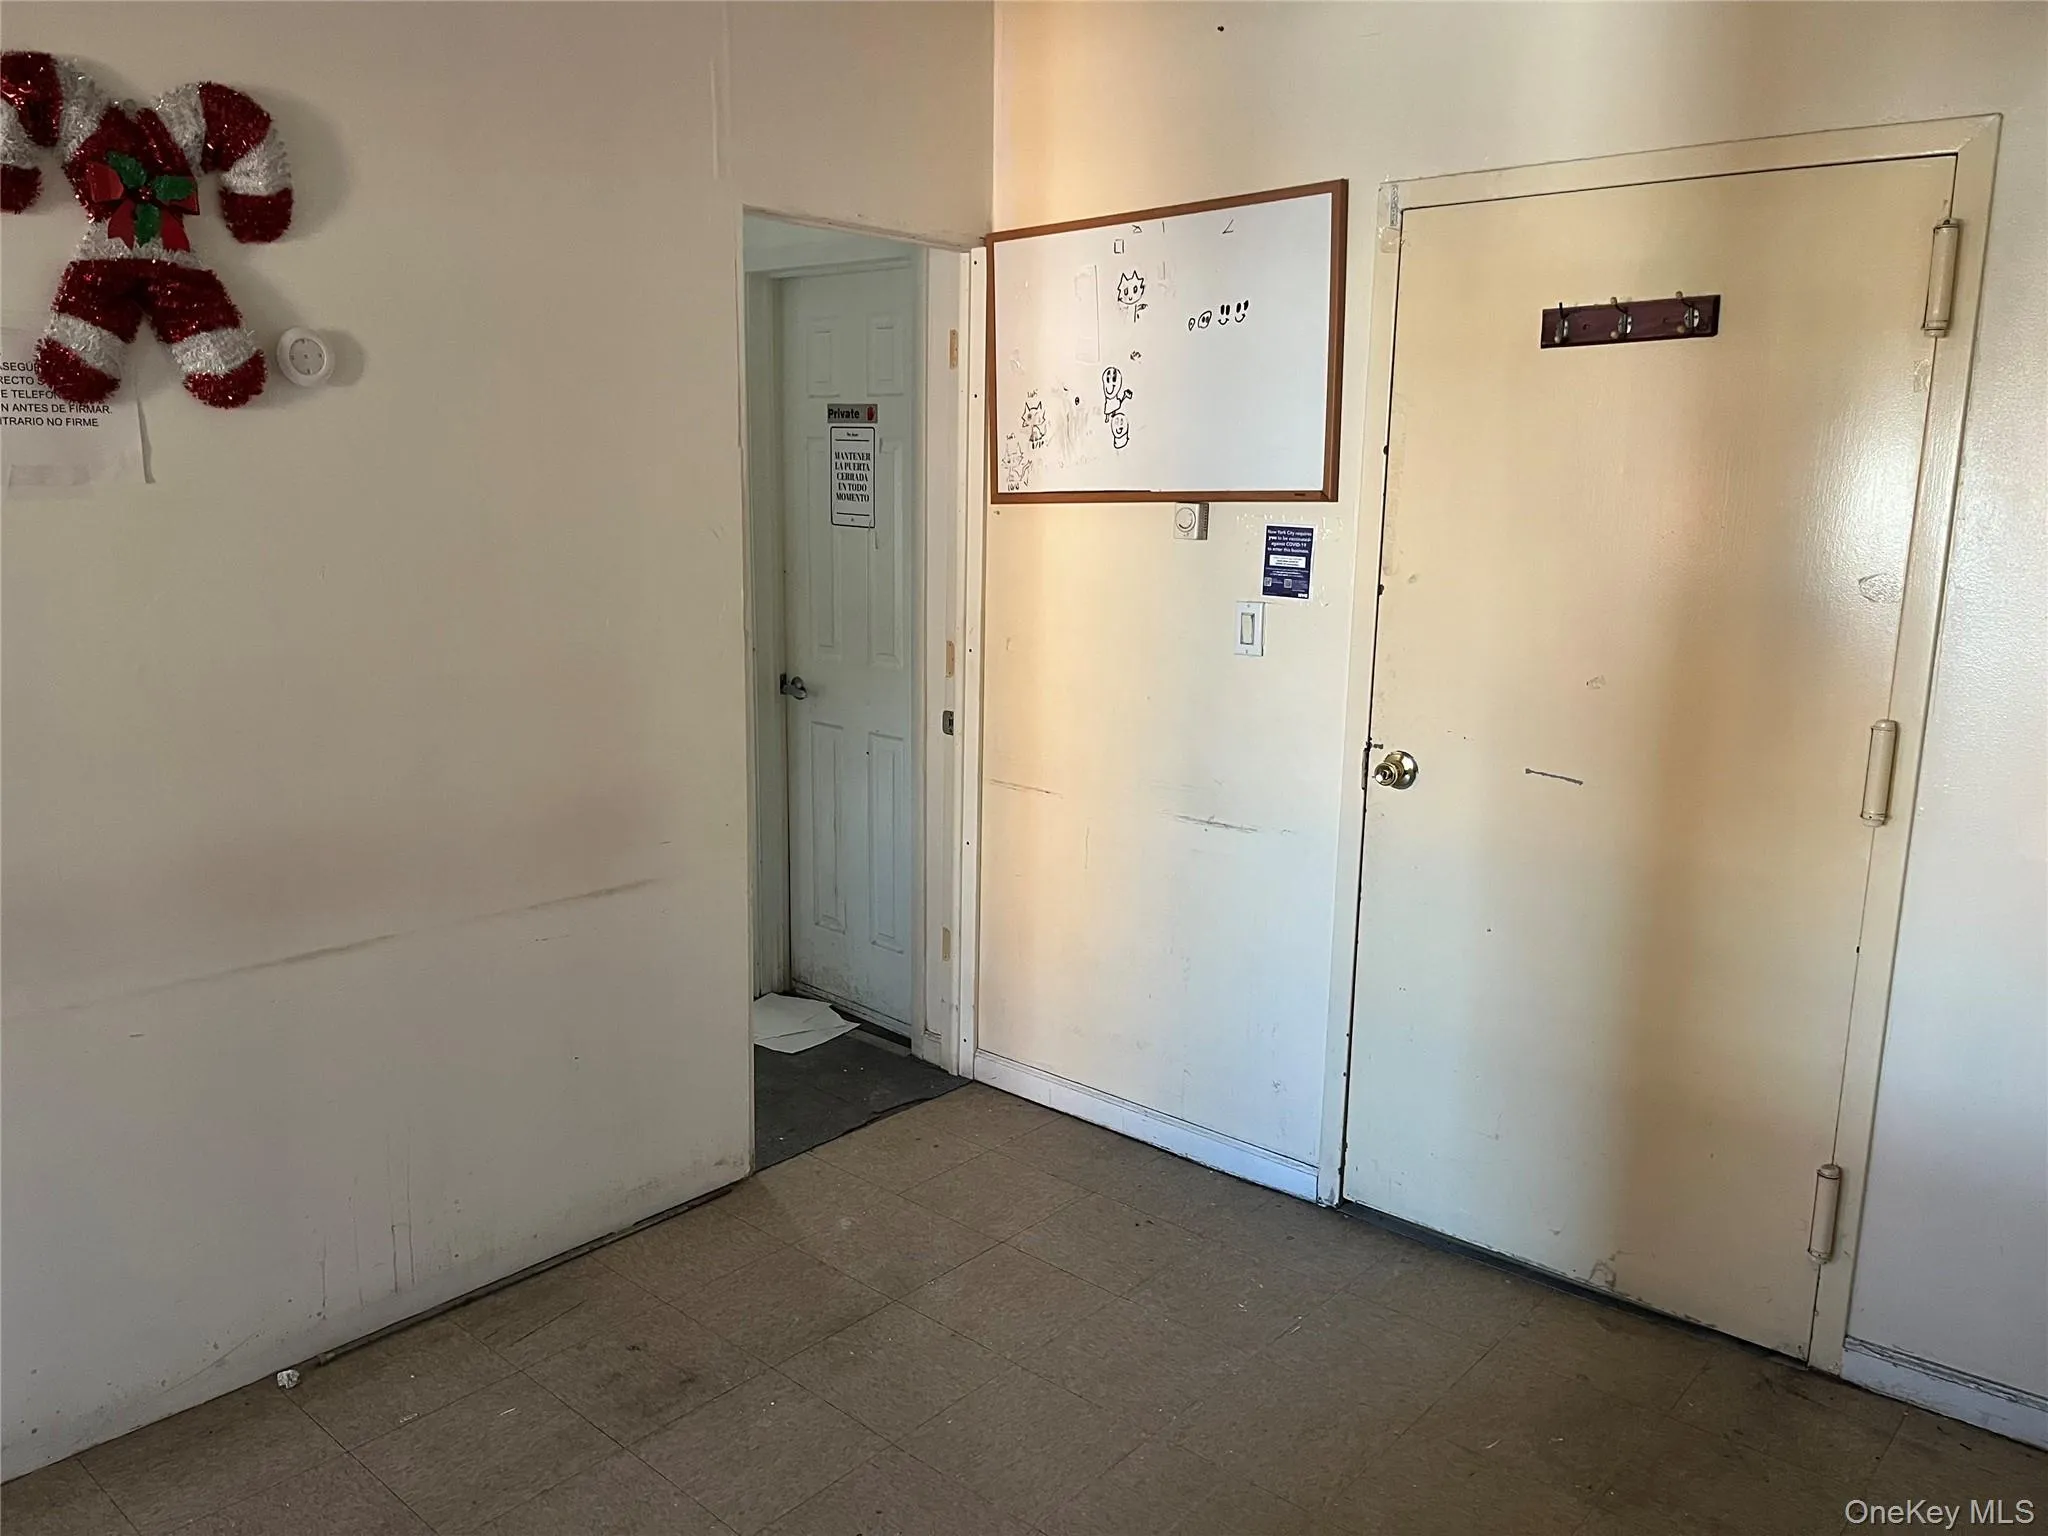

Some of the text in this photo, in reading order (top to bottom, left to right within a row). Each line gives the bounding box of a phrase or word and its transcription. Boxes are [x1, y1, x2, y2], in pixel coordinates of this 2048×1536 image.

[0, 361, 38, 371] SEGU
[12, 403, 48, 412] ANTES
[51, 404, 66, 413] DE
[69, 404, 112, 414] FIRMAR.
[828, 408, 860, 419] Private
[0, 416, 99, 427] TRARIO NO FIRME
[835, 451, 870, 461] MANTENER
[835, 461, 870, 471] LA PUERTA
[836, 472, 868, 481] CERRADA
[838, 482, 867, 491] EN TODO
[836, 492, 870, 502] MOMENTO
